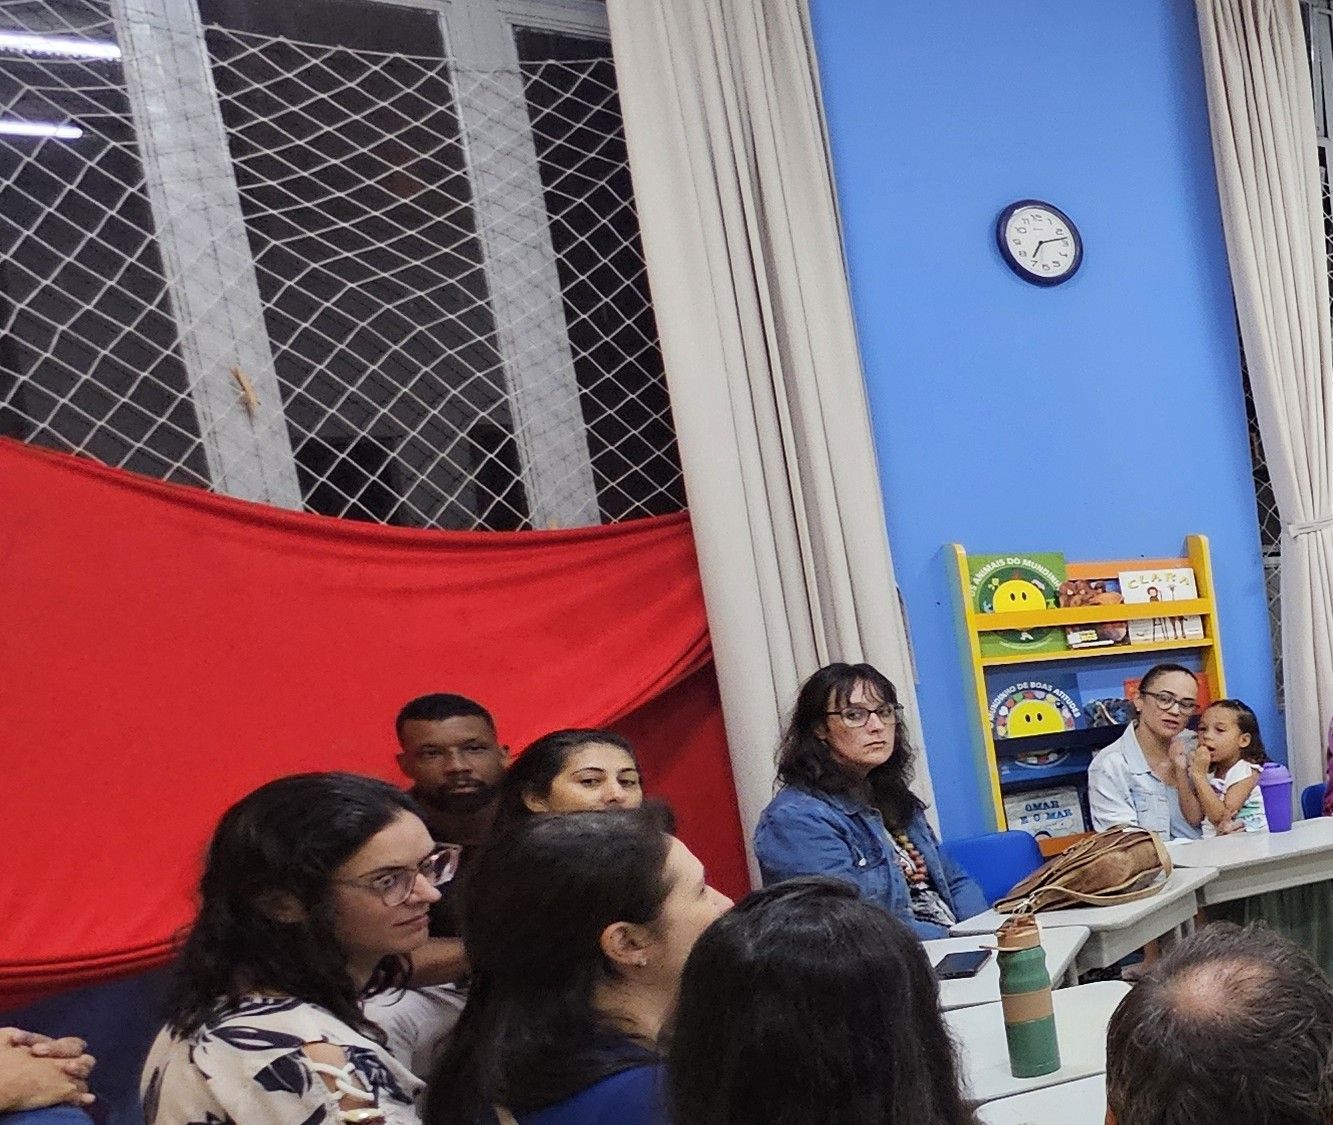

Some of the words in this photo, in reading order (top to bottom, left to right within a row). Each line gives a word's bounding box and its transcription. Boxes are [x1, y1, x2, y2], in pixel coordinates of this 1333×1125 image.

[1127, 572, 1190, 590] CLARA
[1017, 682, 1029, 690] DE
[1030, 681, 1053, 692] BOAS
[1053, 688, 1081, 718] ATITUDES
[1025, 800, 1060, 811] OMAR
[1046, 809, 1073, 819] MAR
